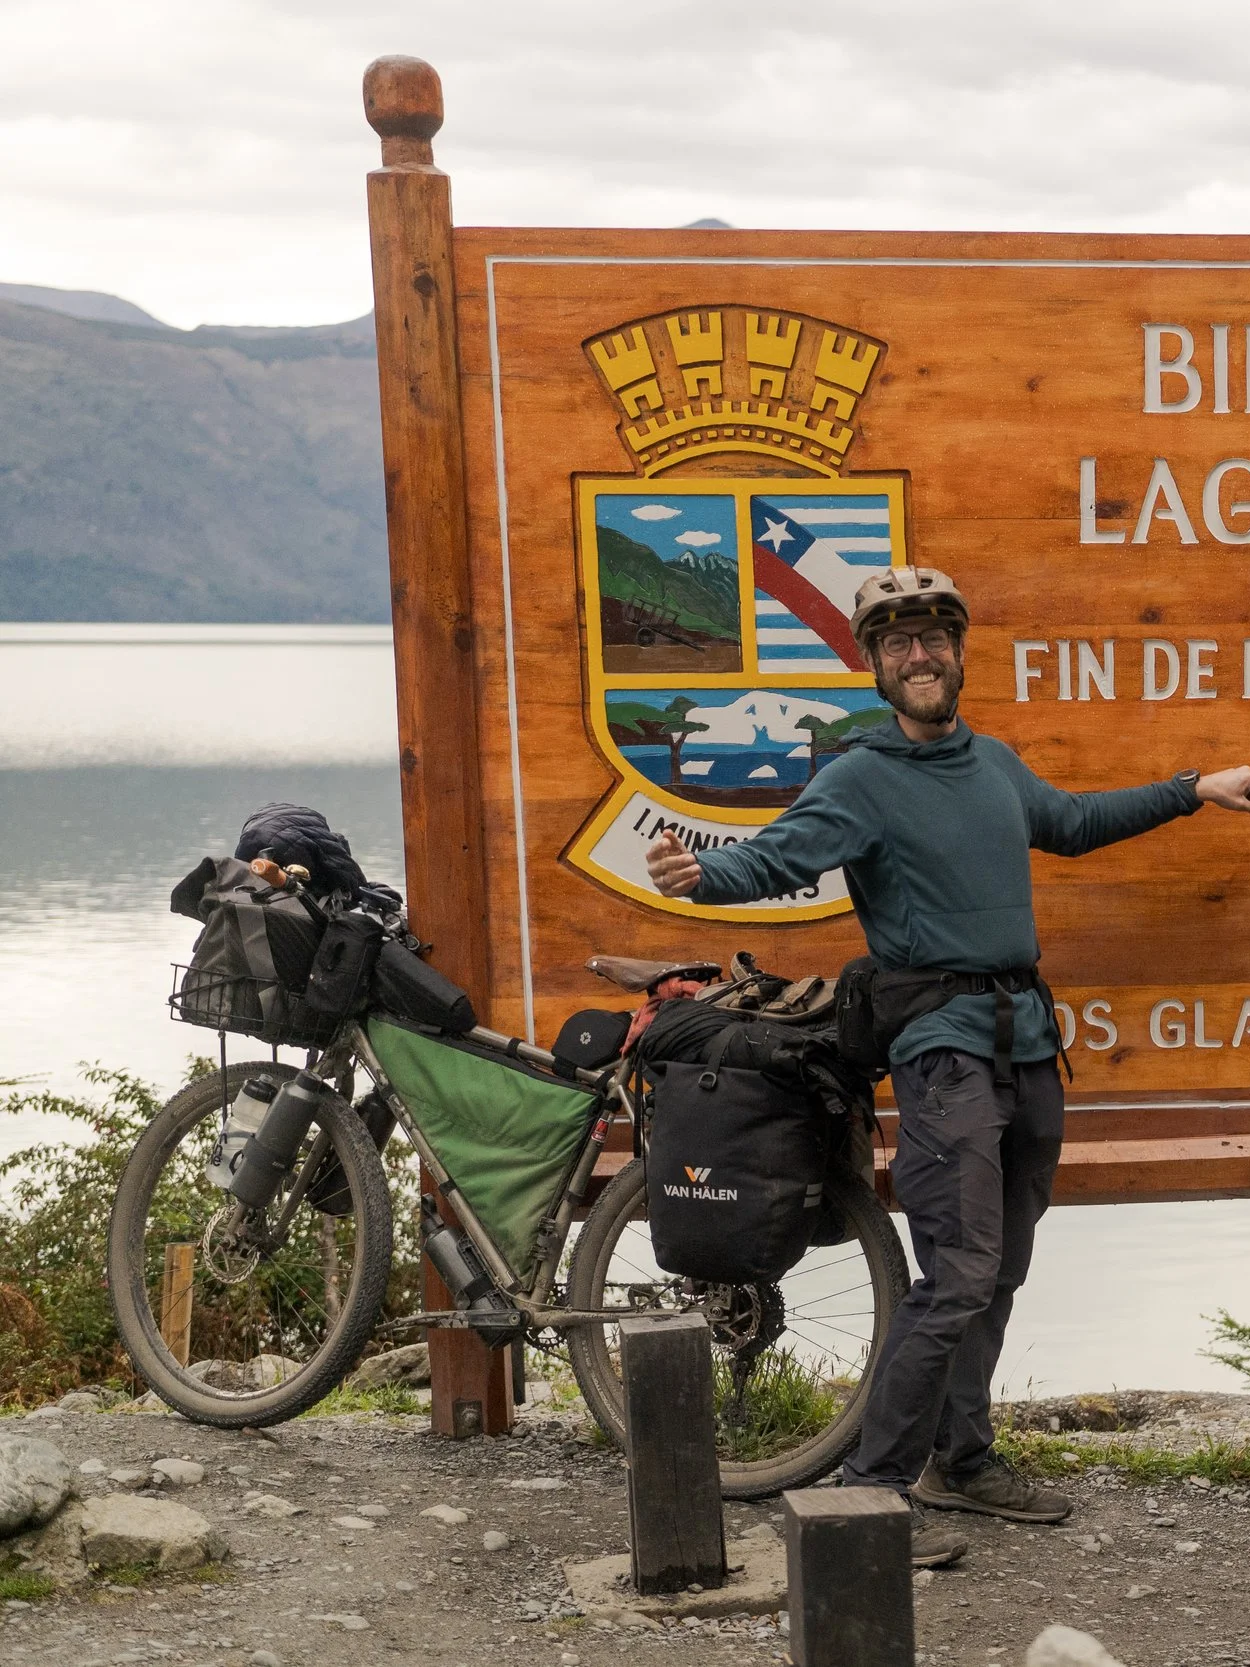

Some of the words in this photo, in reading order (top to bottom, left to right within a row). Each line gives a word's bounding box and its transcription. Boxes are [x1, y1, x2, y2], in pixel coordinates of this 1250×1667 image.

[1014, 639, 1116, 702] FIN
[1143, 639, 1218, 701] DE
[663, 1184, 690, 1198] VAN
[692, 1185, 738, 1201] HÄLEN
